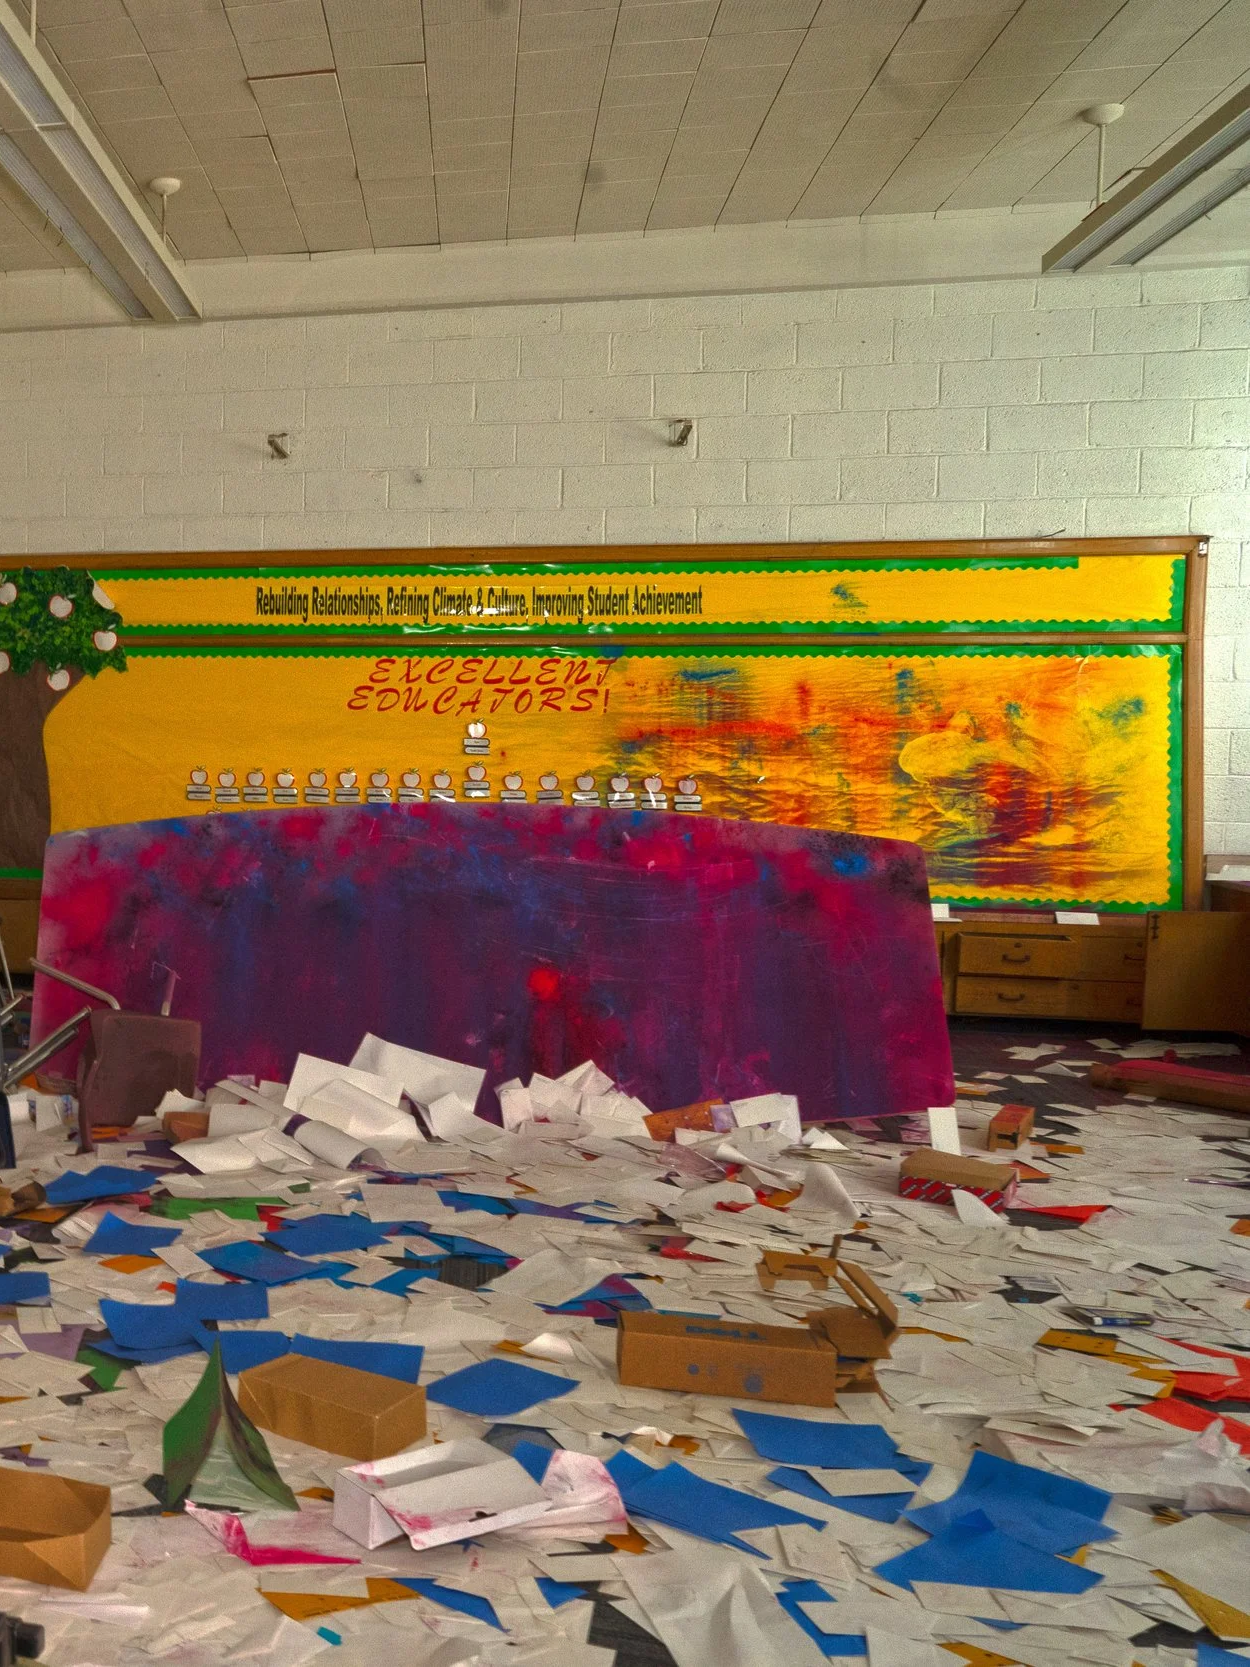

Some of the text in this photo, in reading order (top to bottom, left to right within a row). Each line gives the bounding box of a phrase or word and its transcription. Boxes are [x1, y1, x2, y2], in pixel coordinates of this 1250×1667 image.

[256, 585, 702, 624] Rebuilding Relationships, Refining Climate & Culture, Improving Student Achievement
[368, 658, 617, 686] EXCELLENT
[347, 685, 610, 717] EDUCATORS!
